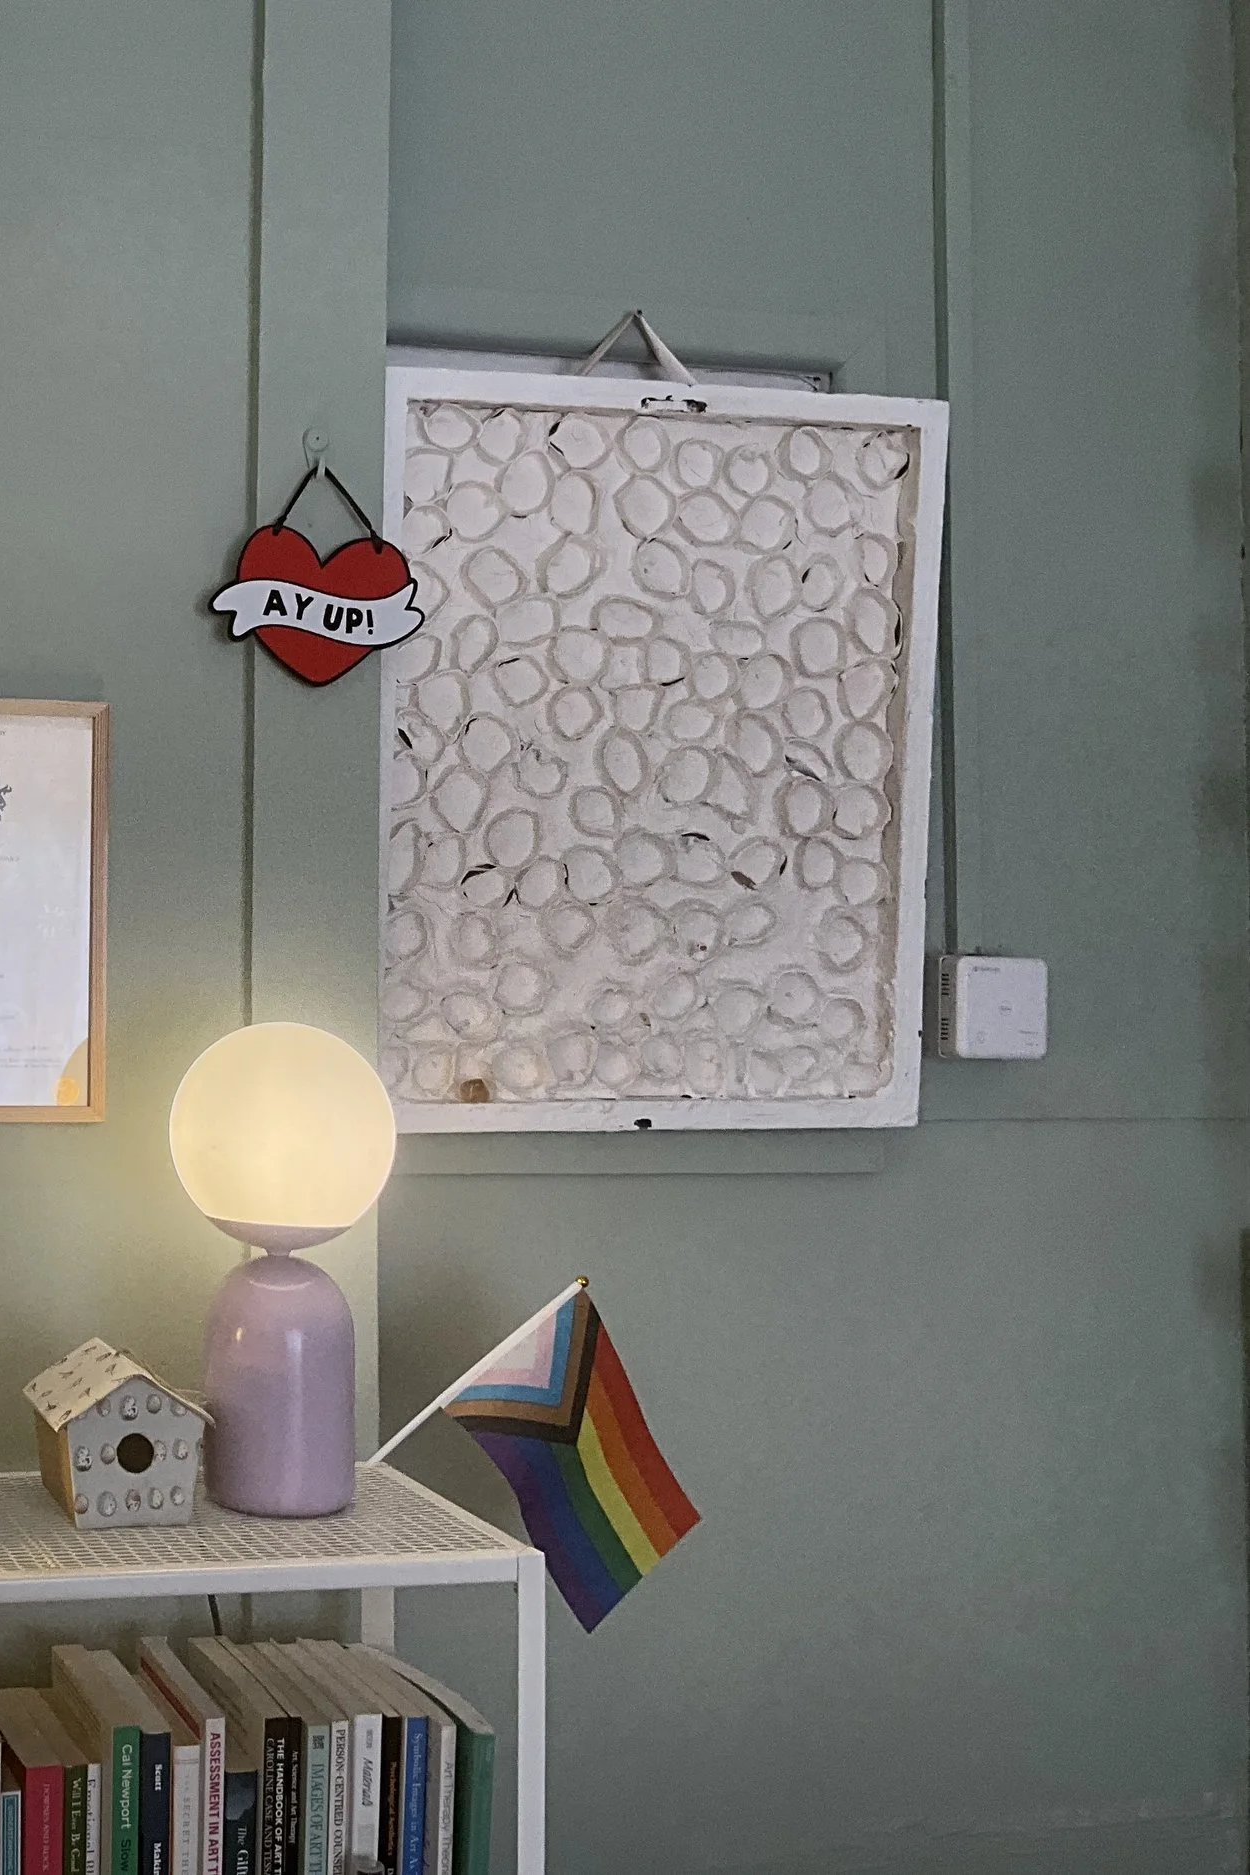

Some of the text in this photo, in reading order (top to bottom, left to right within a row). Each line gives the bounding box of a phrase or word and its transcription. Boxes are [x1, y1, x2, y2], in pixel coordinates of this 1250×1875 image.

[262, 589, 374, 635] AY UP!
[277, 1737, 285, 1759] THE
[411, 1733, 423, 1780] Symbolic
[154, 1763, 162, 1791] Scott
[209, 1732, 221, 1819] ASSESSMENT
[265, 1738, 275, 1794] CAROLINE
[72, 1777, 82, 1799] Will
[120, 1744, 133, 1830] Cal Newport
[275, 1763, 284, 1825] HANDBOOK
[310, 1763, 325, 1812] IMAGES
[410, 1783, 422, 1818] Images
[182, 1797, 191, 1844] SECRET
[265, 1795, 274, 1822] CASE
[208, 1821, 219, 1835] IN
[264, 1823, 273, 1847] AND
[275, 1828, 283, 1841] OF
[310, 1814, 323, 1831] OF
[410, 1821, 417, 1831] in
[120, 1839, 131, 1872] Slow
[208, 1839, 219, 1864] ART
[273, 1844, 283, 1865] ART
[308, 1833, 323, 1859] ART
[409, 1835, 420, 1852] Art
